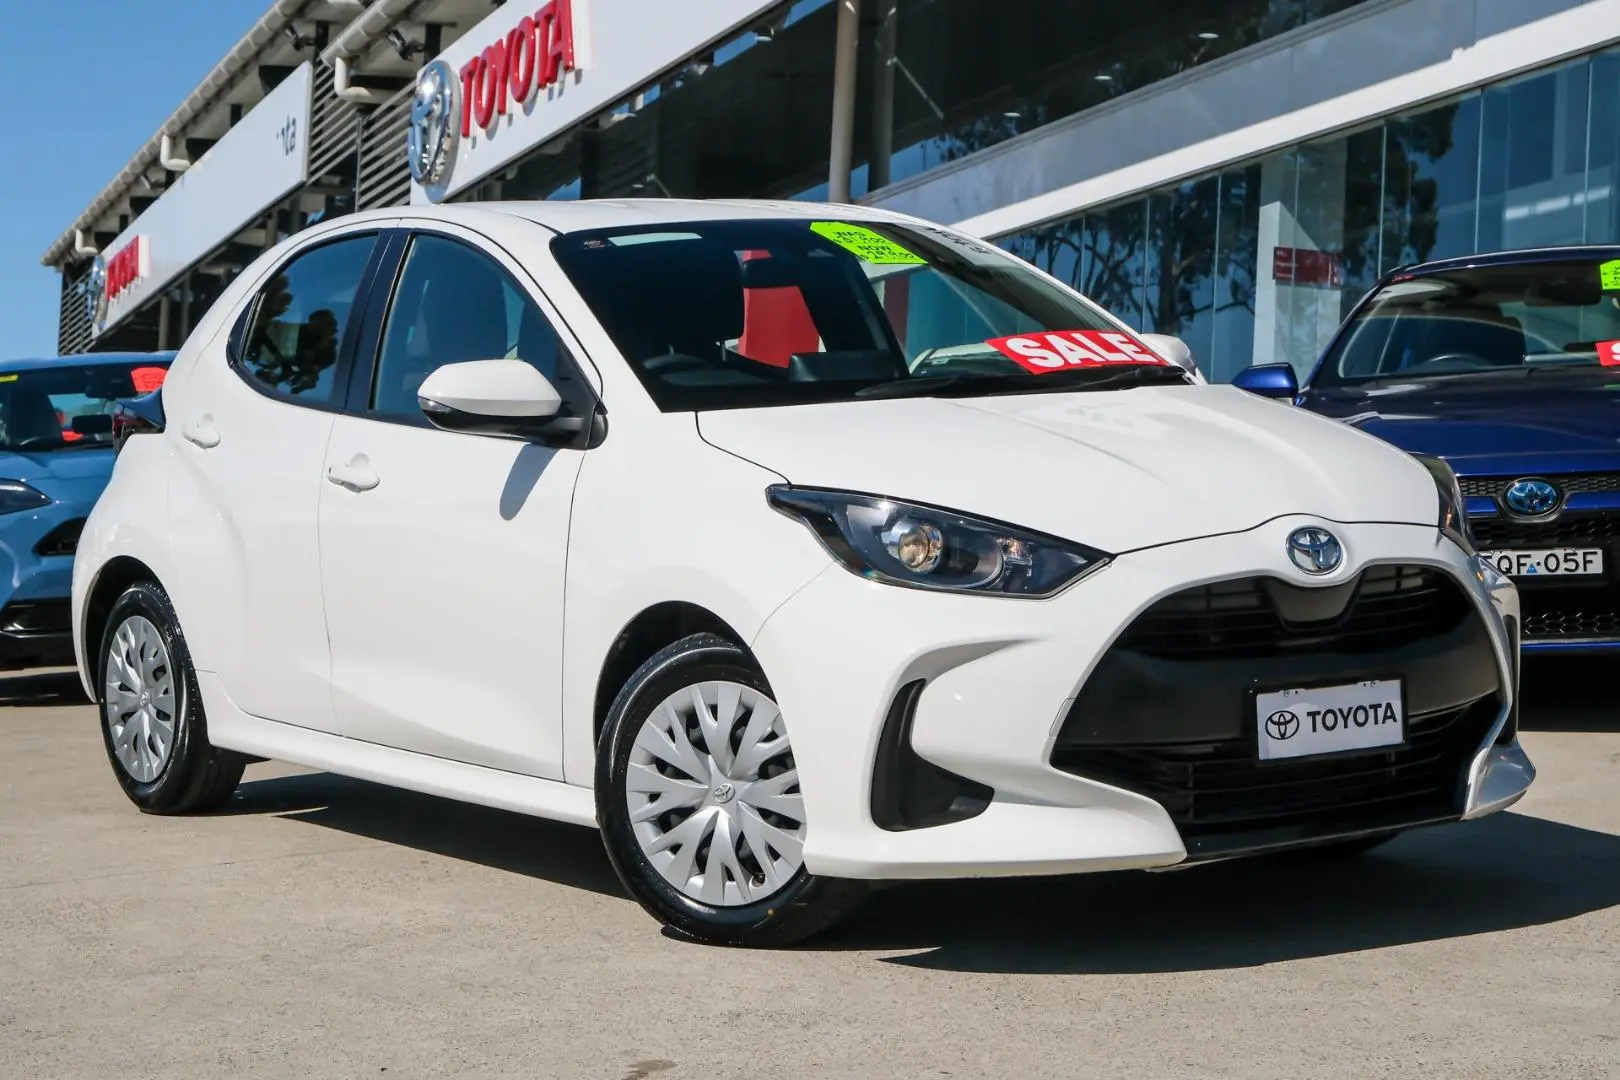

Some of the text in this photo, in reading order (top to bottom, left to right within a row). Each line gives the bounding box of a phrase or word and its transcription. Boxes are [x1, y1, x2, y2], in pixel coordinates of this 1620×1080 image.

[460, 0, 575, 138] TOYOTA
[1005, 332, 1158, 368] SALE
[1306, 702, 1398, 733] TOYOTA
